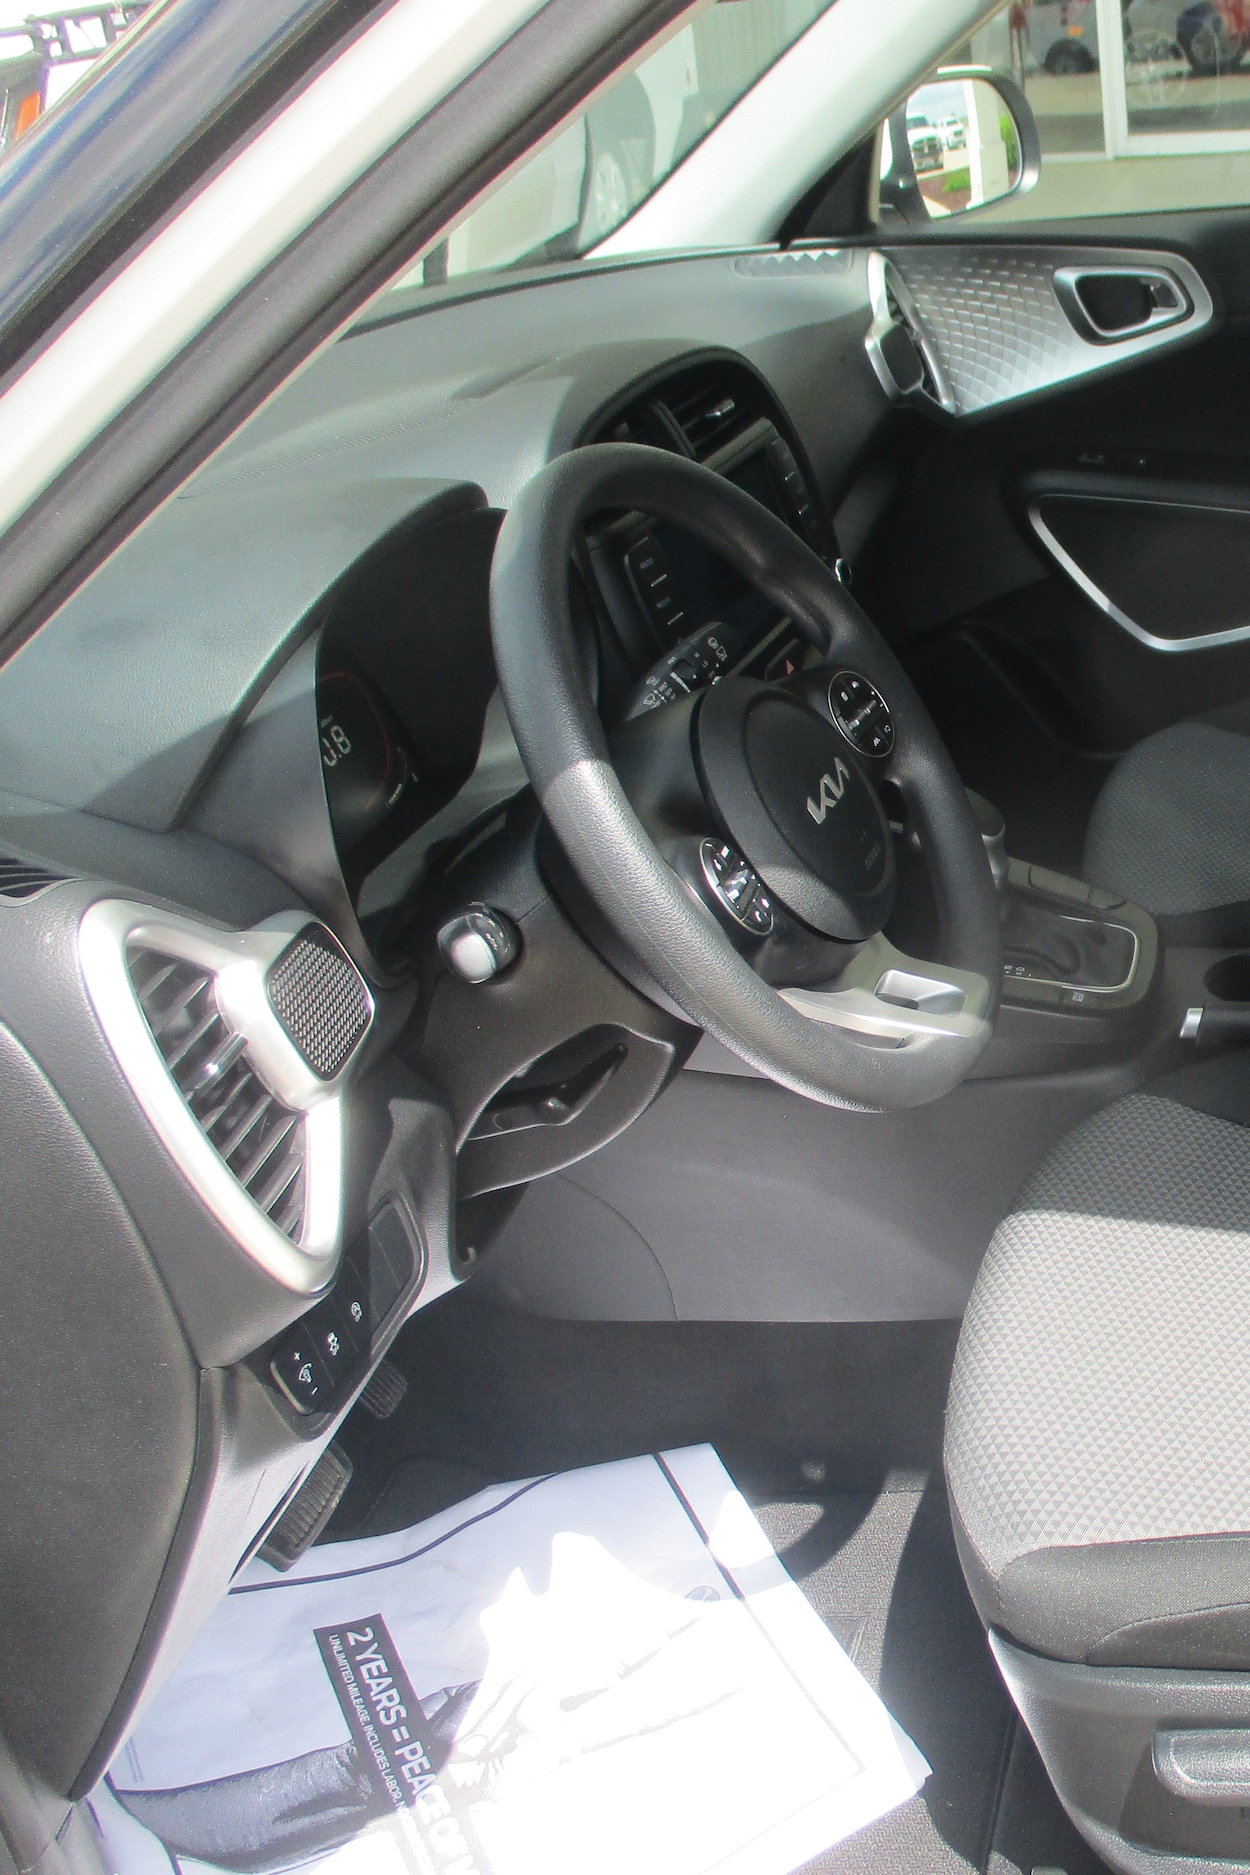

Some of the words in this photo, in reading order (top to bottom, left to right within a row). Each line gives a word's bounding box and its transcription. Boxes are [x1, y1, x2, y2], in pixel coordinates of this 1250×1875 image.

[806, 757, 850, 825] KIA
[346, 1627, 374, 1646] 2
[328, 1633, 354, 1684] UNLIMITED
[347, 1680, 371, 1726] MILEAGE.
[363, 1723, 389, 1770] INCLUDES
[381, 1766, 402, 1804] LABOR.
[355, 1642, 407, 1725] YEARS
[395, 1740, 451, 1824] PEACE
